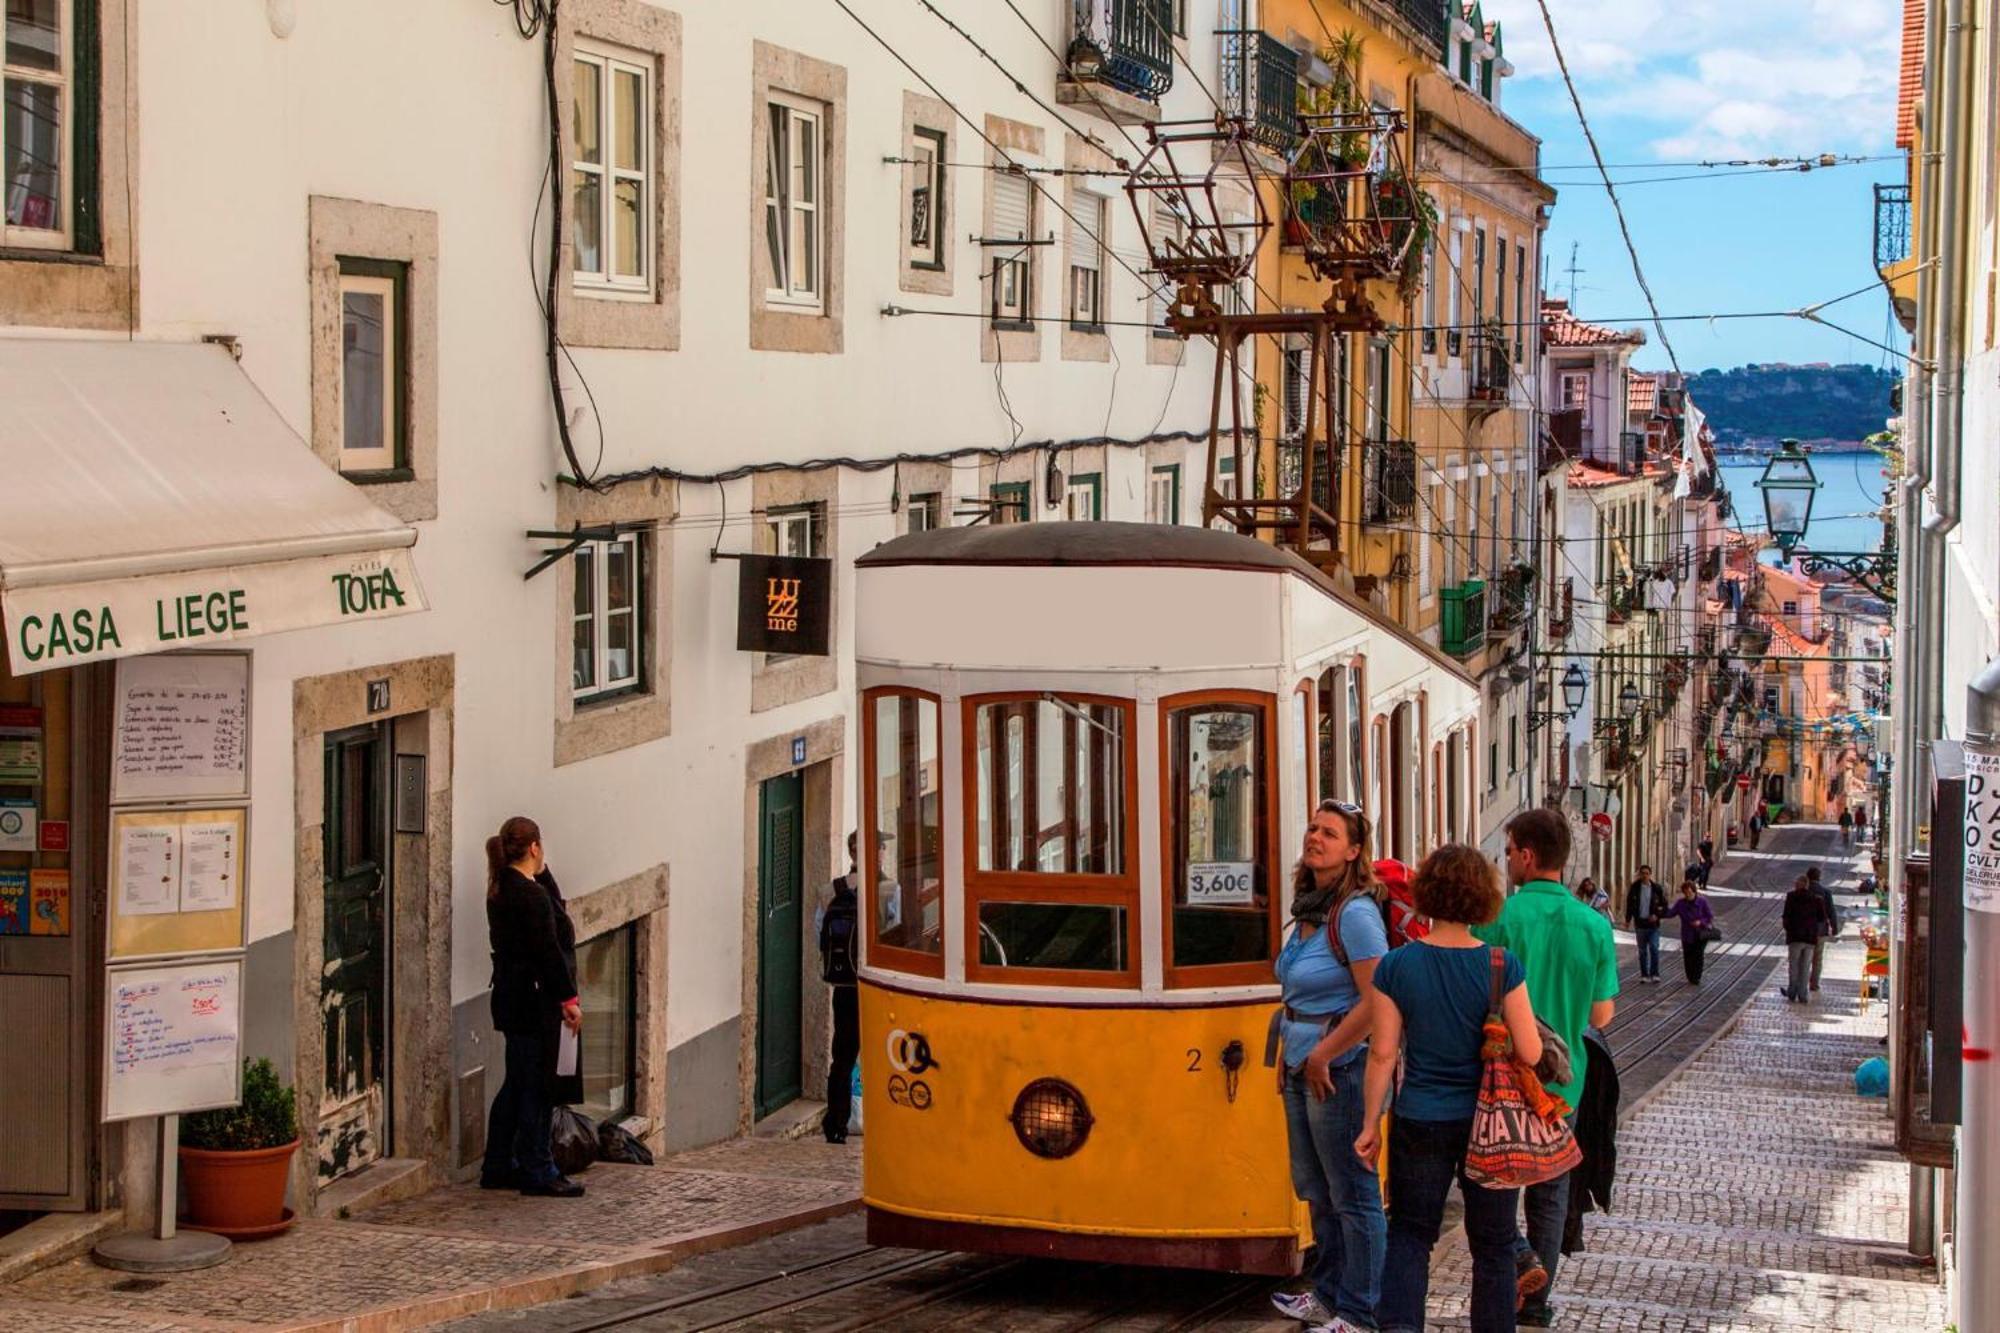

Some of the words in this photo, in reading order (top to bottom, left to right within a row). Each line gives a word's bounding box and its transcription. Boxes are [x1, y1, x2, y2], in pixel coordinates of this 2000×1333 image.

[331, 567, 406, 614] TOFA
[20, 606, 122, 661] CASA
[156, 590, 249, 641] LIEGE
[767, 617, 797, 631] me
[1968, 774, 1984, 795] D
[36, 888, 68, 897] 2010
[1190, 874, 1249, 895] 3,60€
[1186, 1048, 1202, 1072] 2
